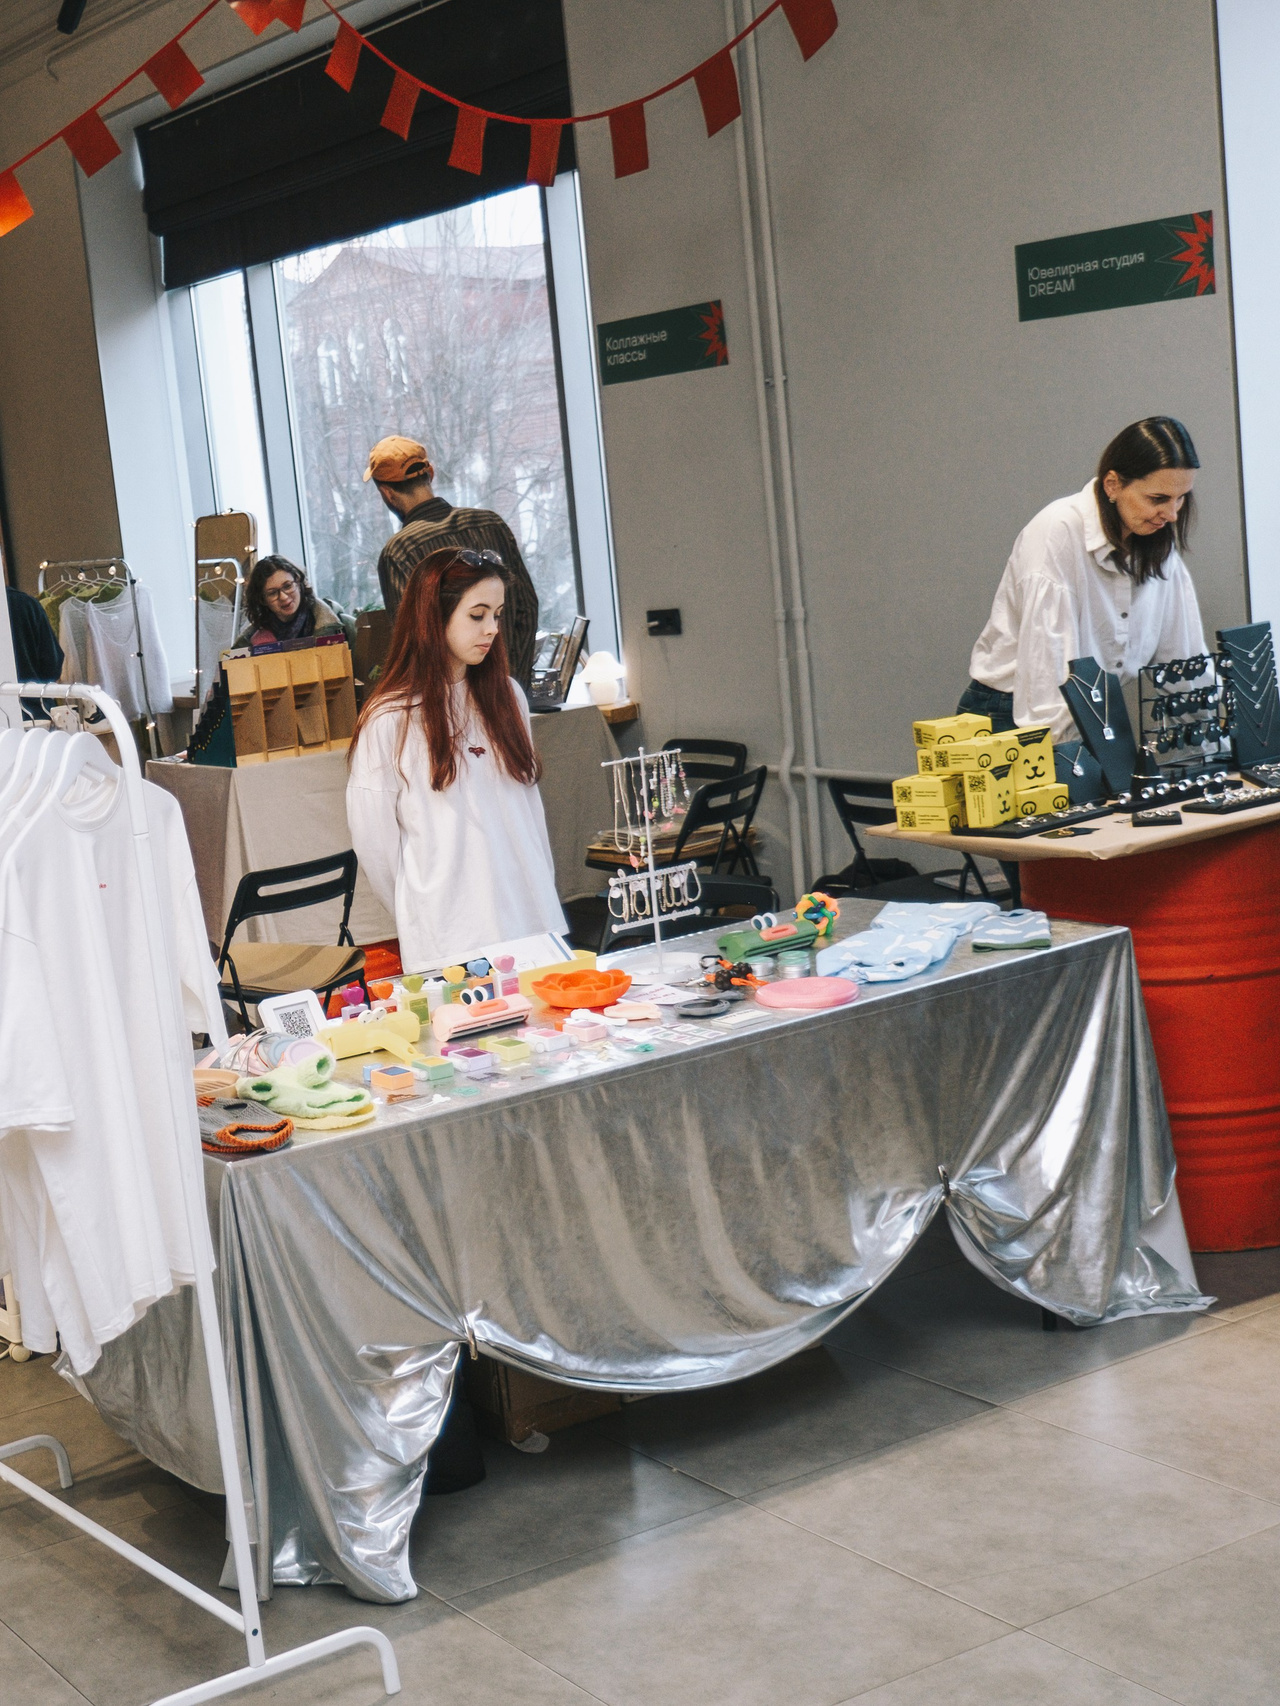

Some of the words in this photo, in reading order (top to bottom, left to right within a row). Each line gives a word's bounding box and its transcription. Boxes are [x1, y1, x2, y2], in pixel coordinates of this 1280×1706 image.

[1027, 260, 1099, 281] Ювелирная
[1101, 252, 1145, 271] студия
[1028, 278, 1075, 298] DREAM
[605, 330, 668, 352] Коллажные
[606, 349, 647, 366] классы
